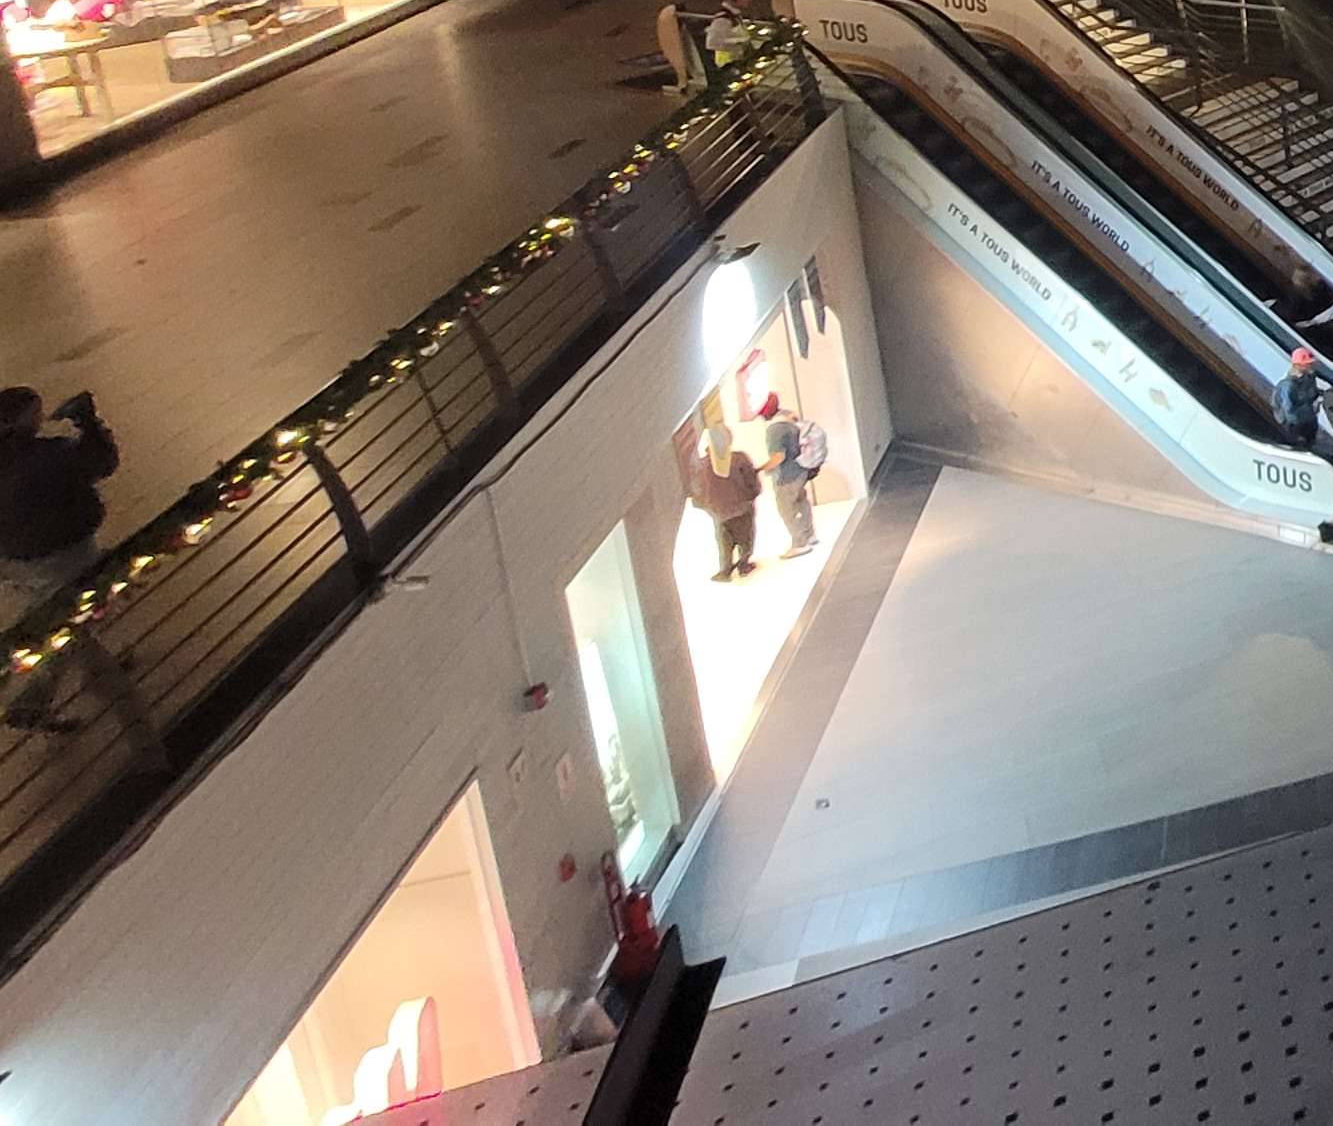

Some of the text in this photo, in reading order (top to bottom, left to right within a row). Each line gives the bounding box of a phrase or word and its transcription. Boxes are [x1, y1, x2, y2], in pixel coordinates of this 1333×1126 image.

[819, 19, 868, 44] TOUS
[1176, 150, 1202, 179] TOUS
[1202, 175, 1240, 212] WORLD
[1051, 180, 1062, 193] A
[1062, 187, 1091, 218] TOUS
[1090, 212, 1131, 254] WORLD
[947, 202, 1053, 303] IT'S A TOUS WORLD
[1252, 459, 1313, 493] TOUS
